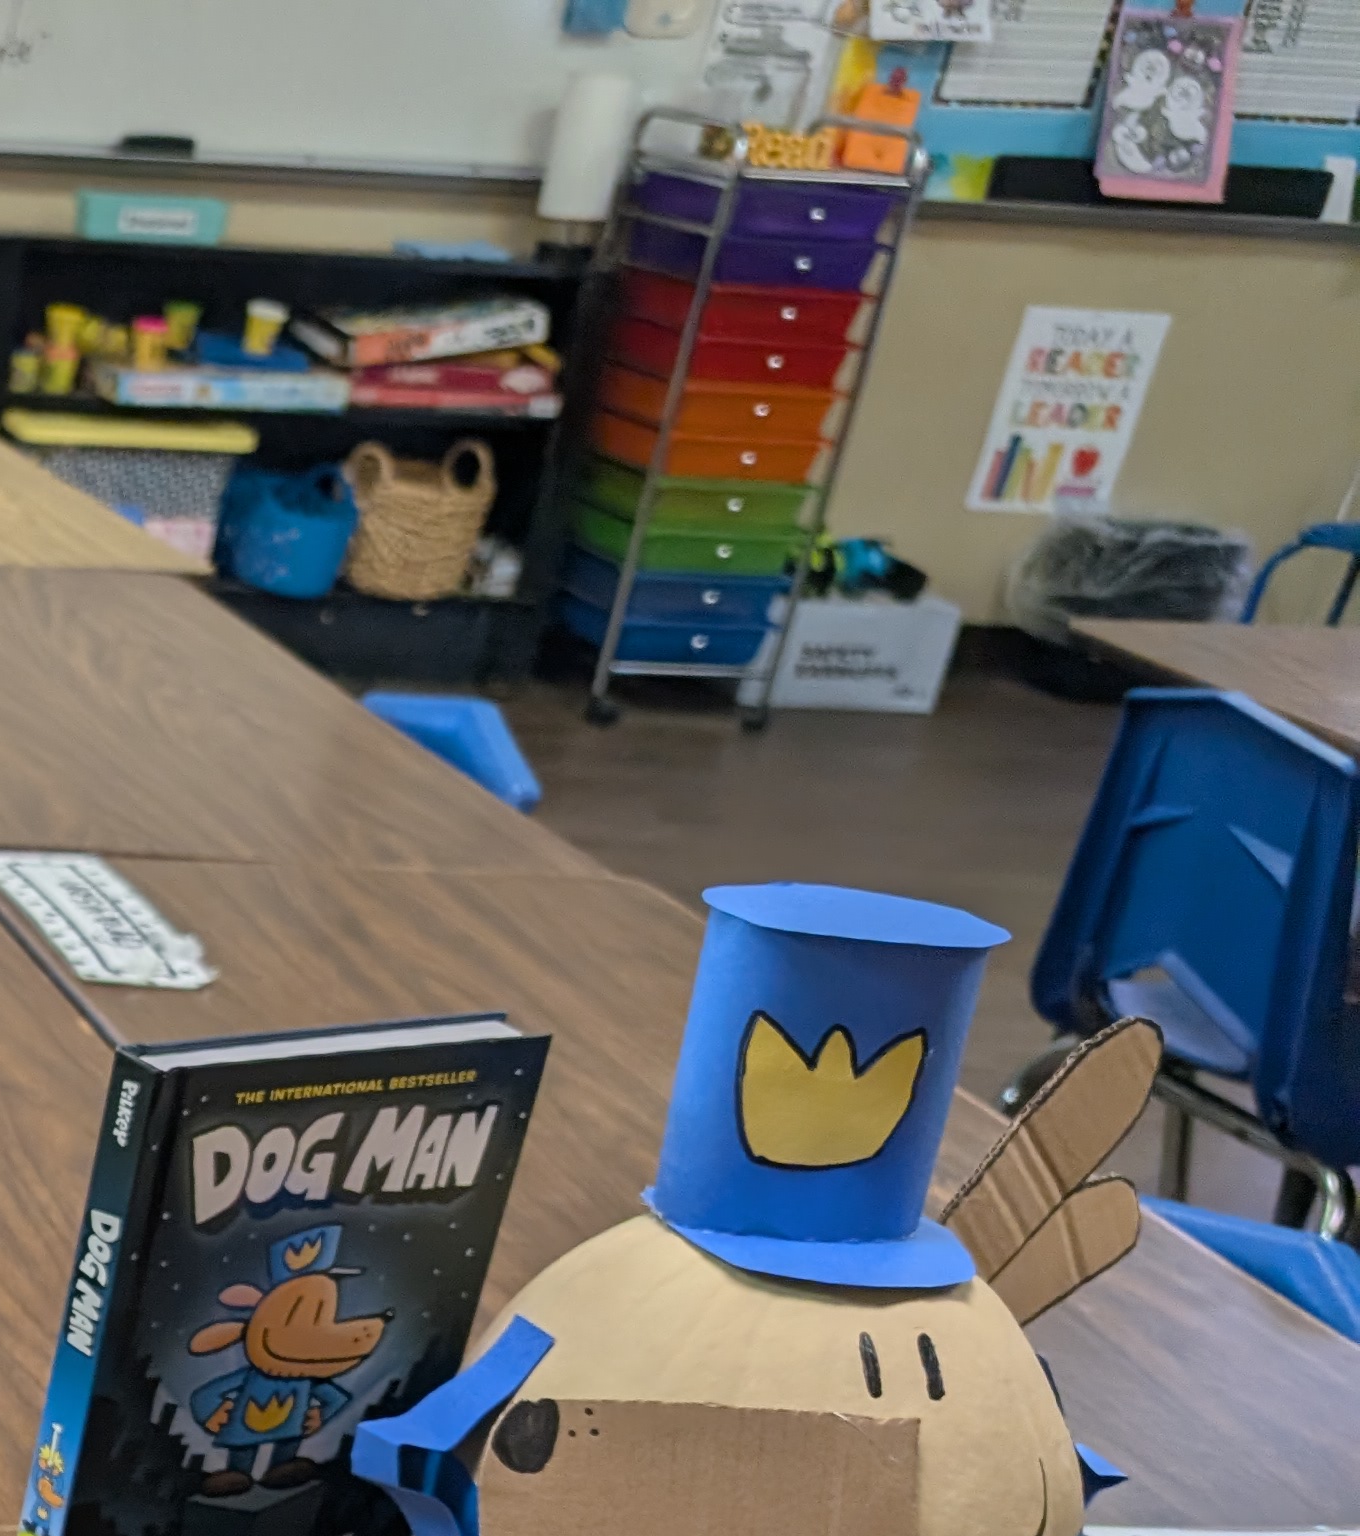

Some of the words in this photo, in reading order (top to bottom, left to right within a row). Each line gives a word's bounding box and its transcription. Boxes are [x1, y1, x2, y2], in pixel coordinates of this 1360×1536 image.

[1026, 347, 1140, 379] READER
[1008, 399, 1122, 433] LEADER
[236, 1091, 265, 1105] THE
[269, 1078, 384, 1102] INTERNATIONAL
[388, 1068, 477, 1091] BESTSELLER
[192, 1111, 346, 1226] DOG
[342, 1104, 498, 1193] MAN
[79, 1208, 122, 1288] DOG
[66, 1278, 102, 1357] MAN
